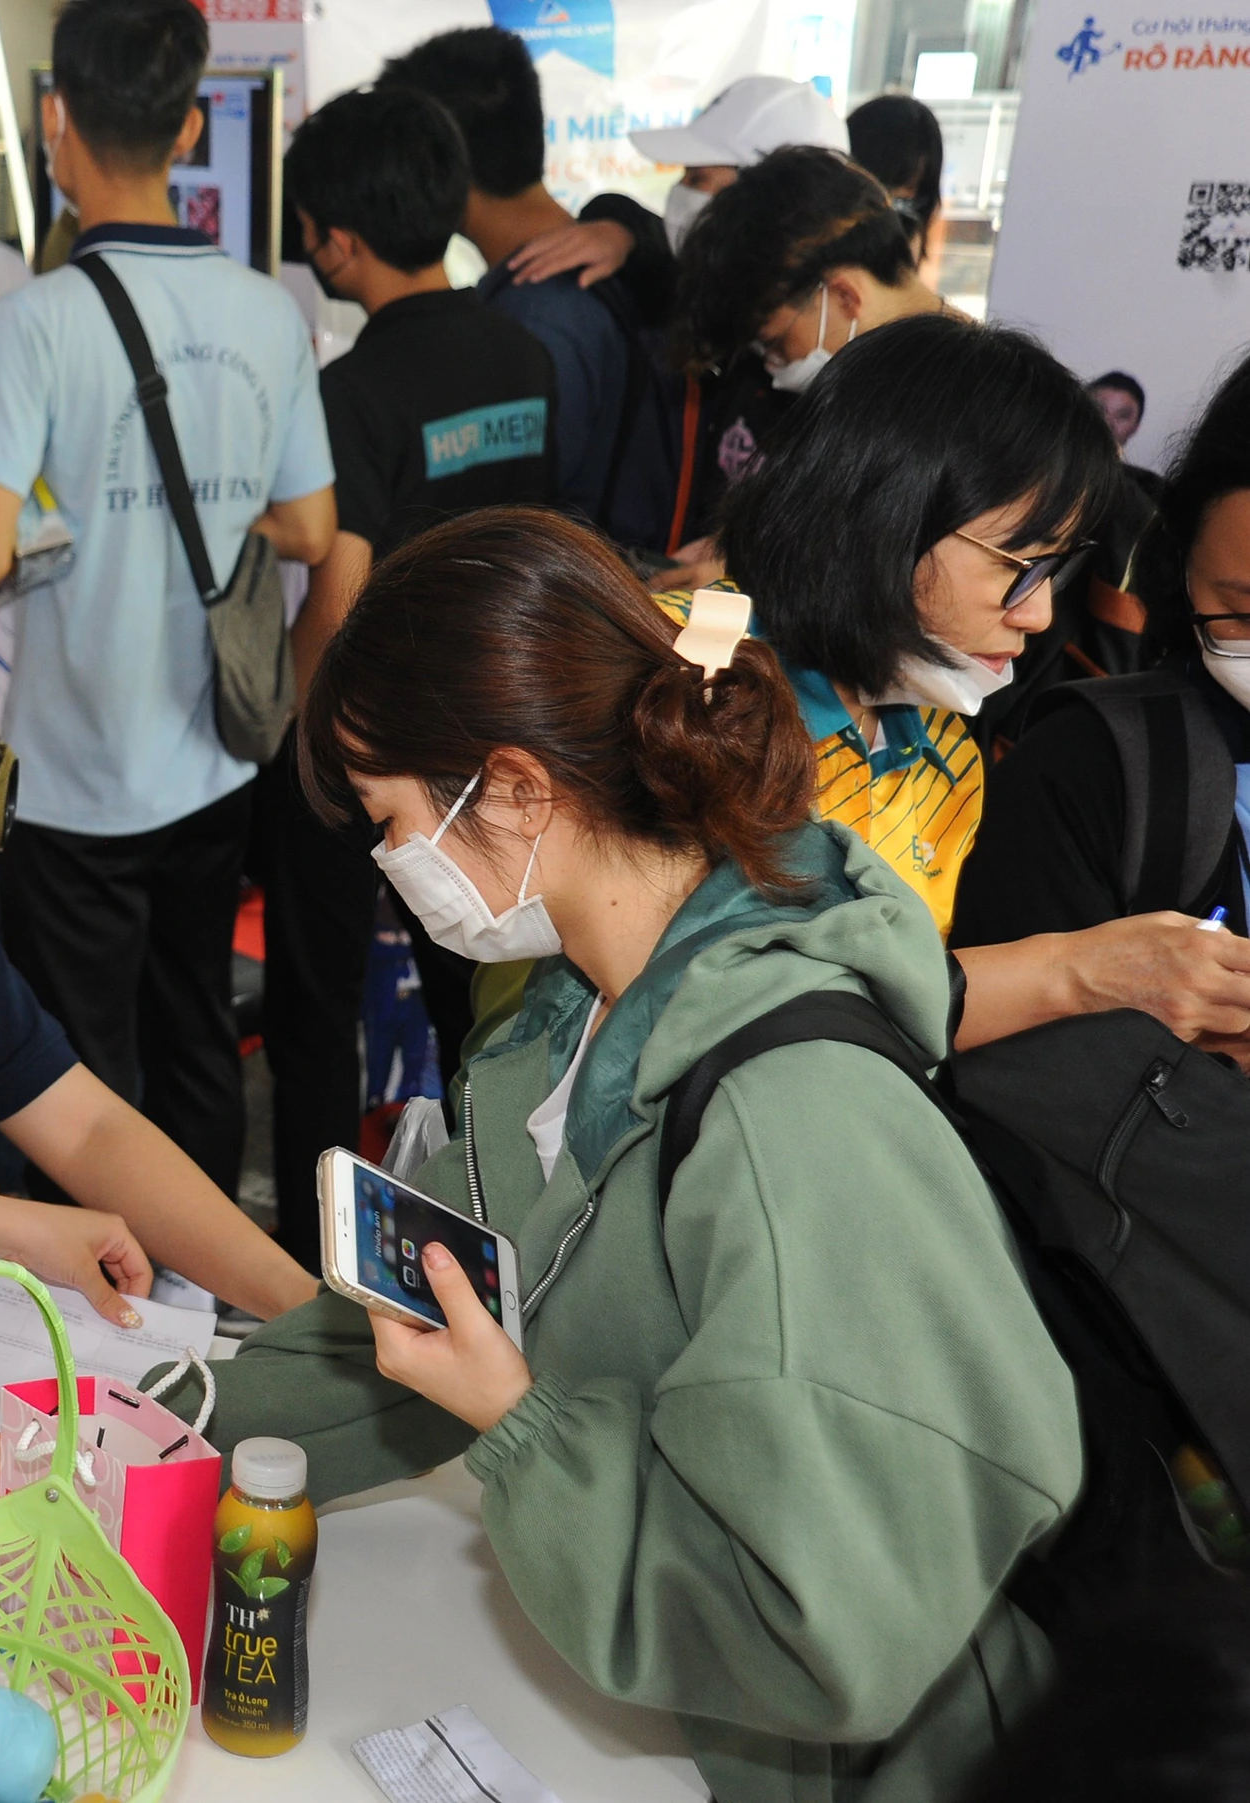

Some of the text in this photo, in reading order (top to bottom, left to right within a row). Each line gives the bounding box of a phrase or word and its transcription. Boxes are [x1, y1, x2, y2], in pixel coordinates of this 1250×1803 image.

[226, 1602, 255, 1630] TH
[224, 1622, 278, 1657] true
[223, 1647, 277, 1685] TEA
[224, 1688, 237, 1701] Trà
[246, 1693, 269, 1707] Long
[238, 1704, 264, 1717] Nhiên
[241, 1719, 257, 1731] 350
[258, 1720, 270, 1731] ml
